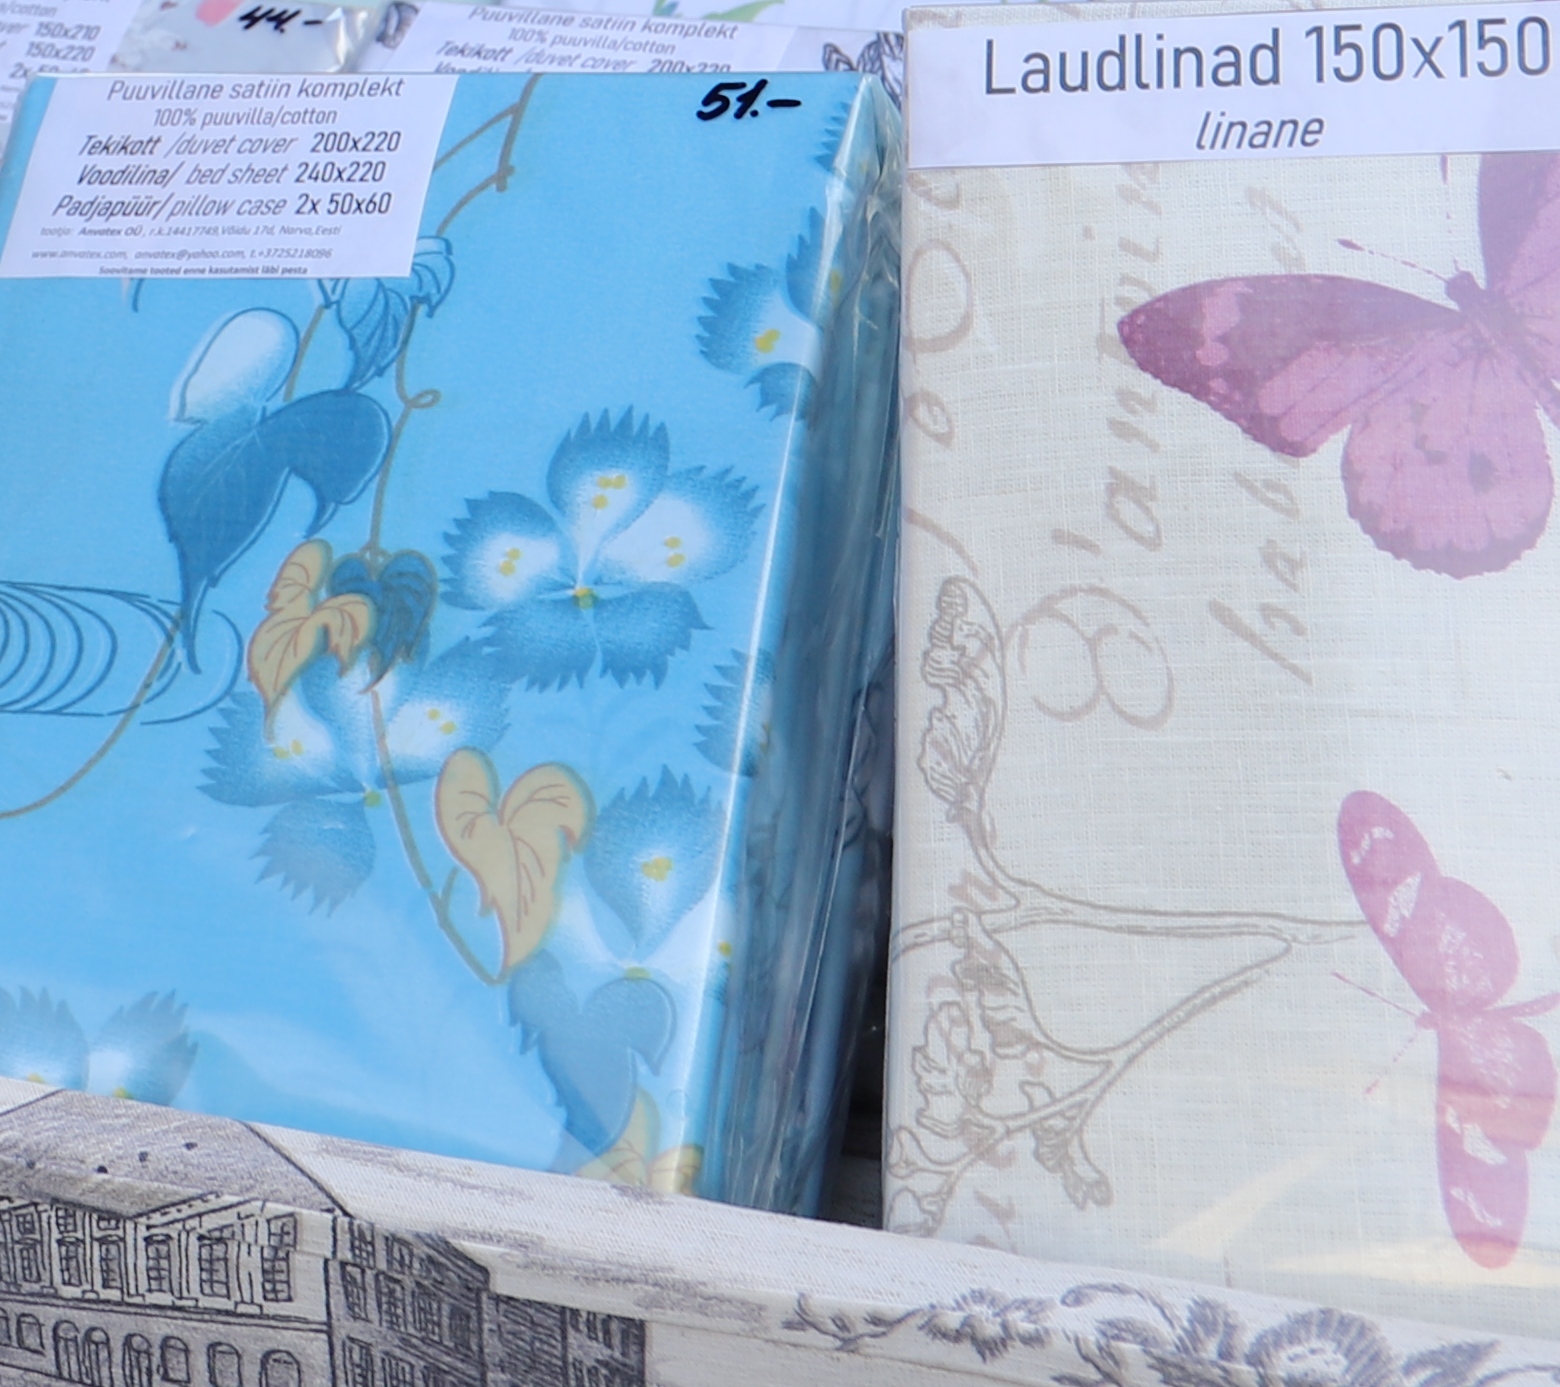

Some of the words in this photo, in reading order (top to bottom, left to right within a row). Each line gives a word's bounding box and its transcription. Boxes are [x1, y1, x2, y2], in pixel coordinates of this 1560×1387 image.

[983, 27, 1282, 96] Laudlinad
[1303, 15, 1553, 83] 150x150
[107, 80, 223, 102] Puuvillane
[229, 79, 290, 101] satiin
[297, 77, 405, 102] komplekt
[696, 78, 803, 122] 51.-
[154, 108, 197, 127] 100%
[200, 107, 338, 128] puuvilla/cotton
[1193, 109, 1326, 152] linane
[78, 135, 161, 157] Tekikott
[237, 136, 299, 154] cover
[310, 131, 402, 154] 200x220
[185, 164, 223, 186] bed
[226, 164, 290, 186] sheet
[293, 160, 387, 183] 240x220
[235, 197, 287, 216] case
[294, 194, 320, 216] 2x
[326, 191, 392, 215] 50x60
